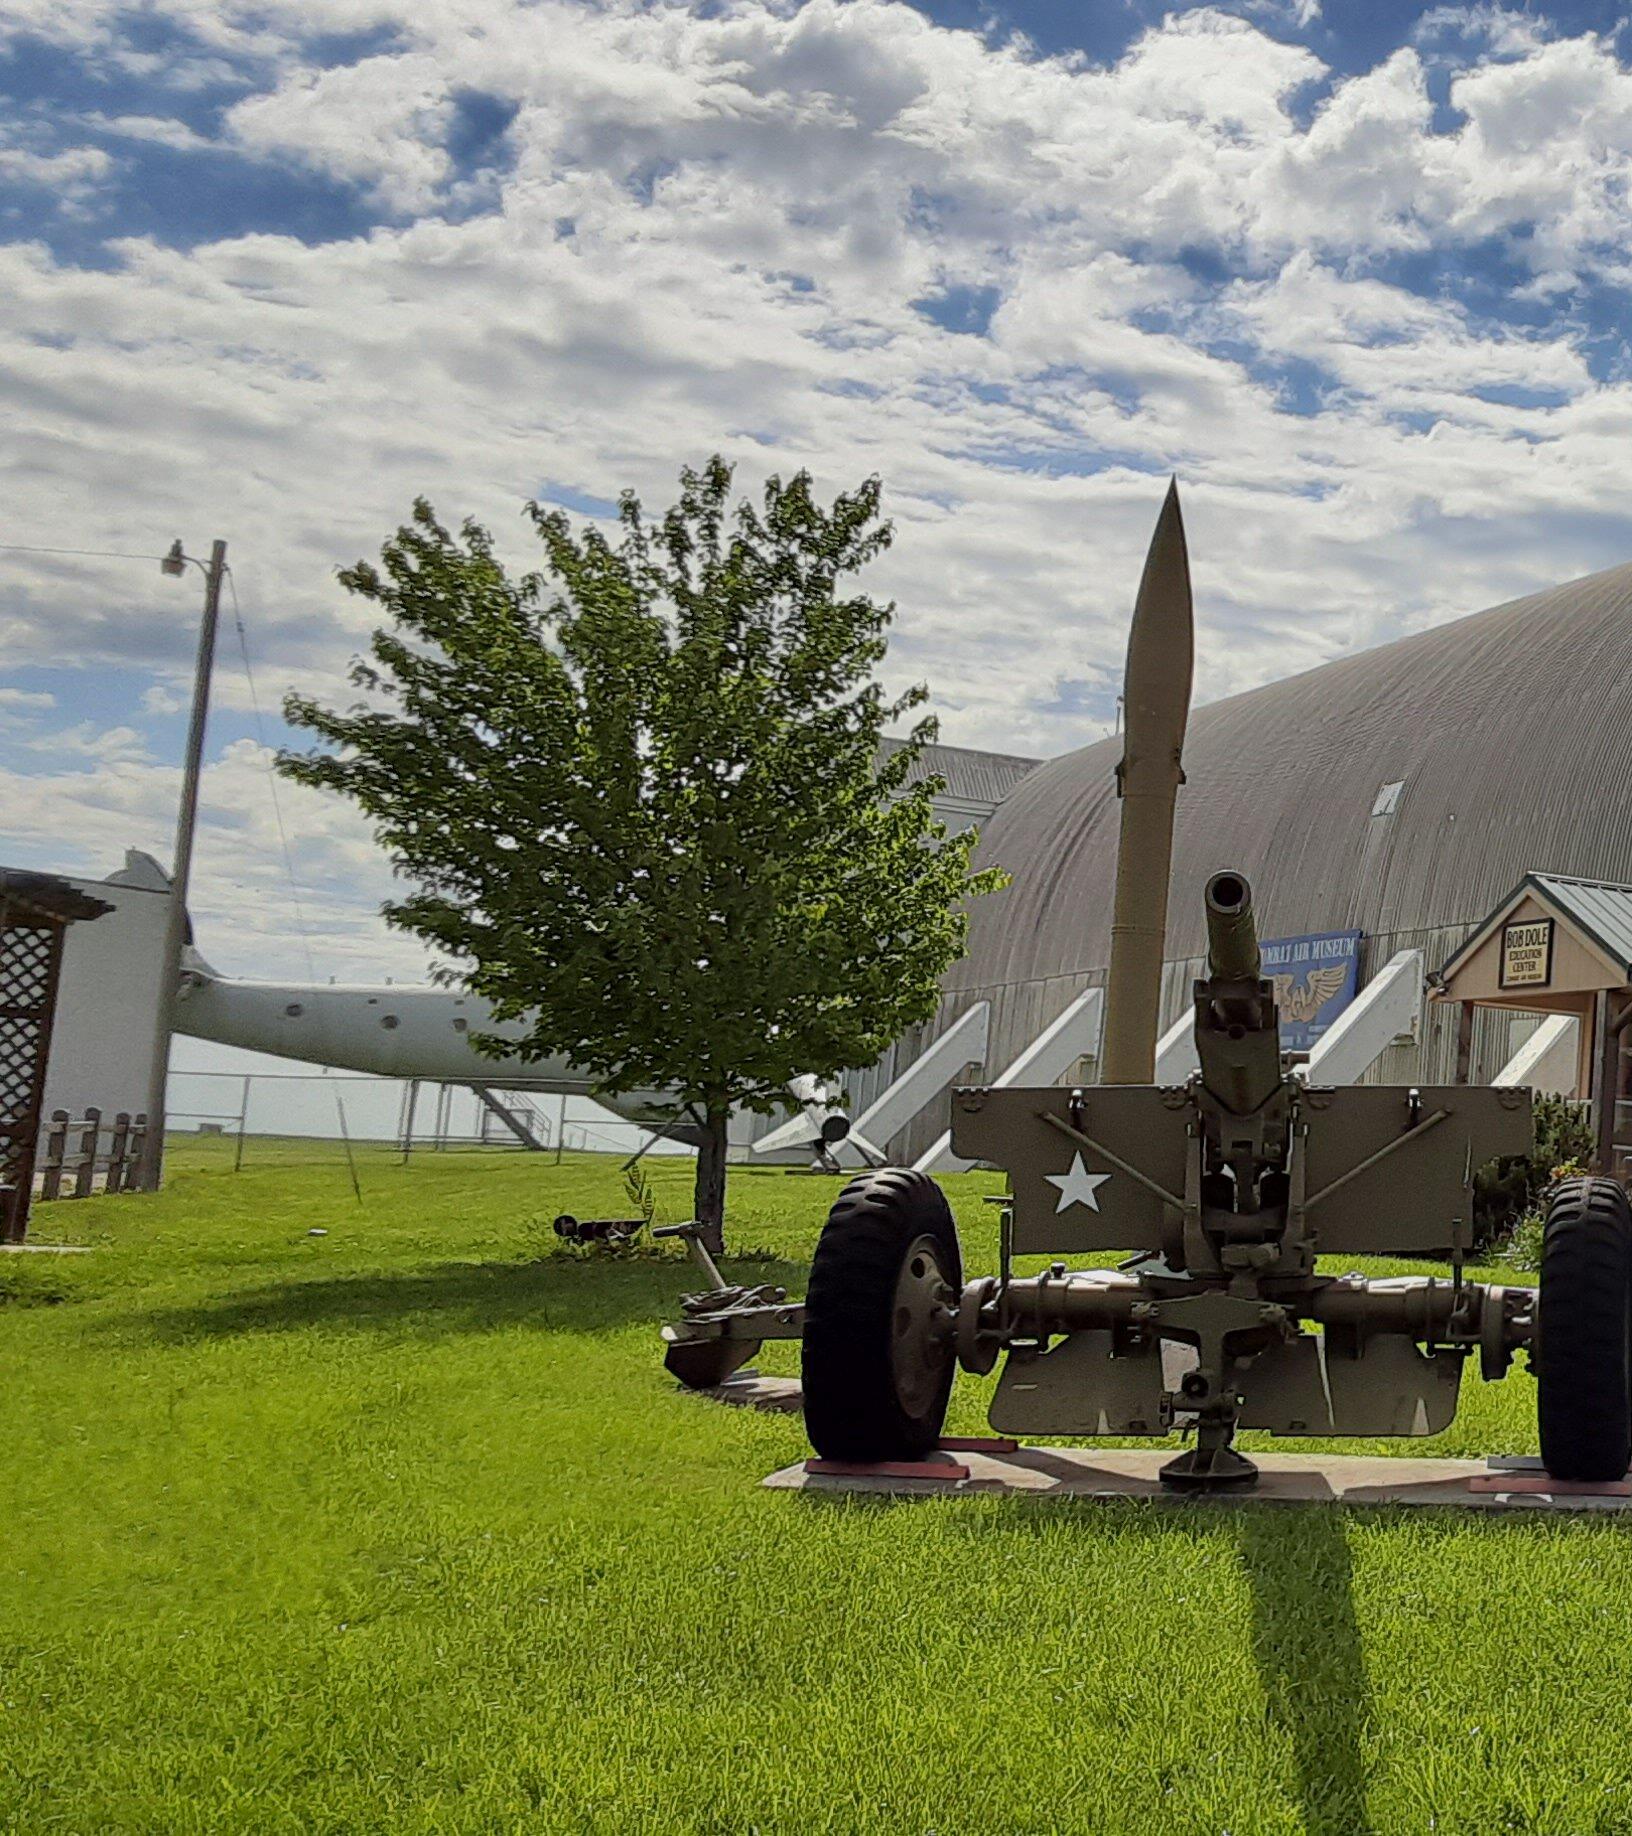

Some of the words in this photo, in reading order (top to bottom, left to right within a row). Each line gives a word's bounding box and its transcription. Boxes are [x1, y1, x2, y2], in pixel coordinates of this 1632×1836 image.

[1507, 930, 1524, 948] BOB
[1525, 927, 1548, 946] DOLE
[1294, 943, 1309, 961] AIR
[1311, 938, 1355, 960] MUSEUM
